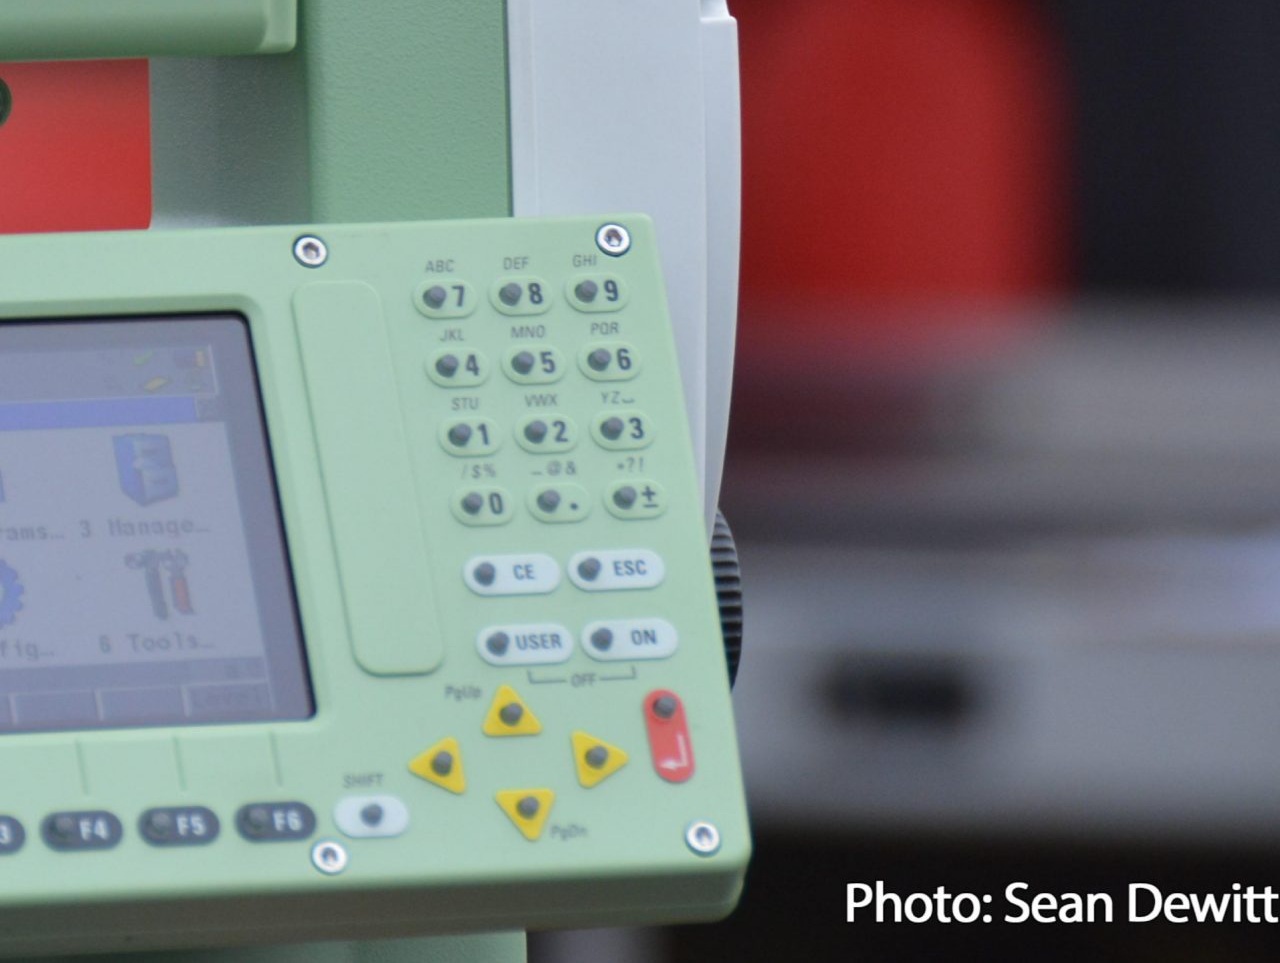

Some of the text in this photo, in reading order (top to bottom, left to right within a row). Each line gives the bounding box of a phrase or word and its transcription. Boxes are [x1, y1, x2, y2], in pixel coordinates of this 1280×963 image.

[425, 260, 455, 273] ABC
[503, 256, 530, 270] DEF
[572, 254, 597, 268] GHI
[451, 285, 465, 307] 7
[528, 282, 543, 305] 8
[604, 279, 619, 302] 9
[440, 328, 464, 342] JKL
[511, 325, 546, 339] MNO
[591, 322, 619, 336] PQR
[465, 354, 480, 376] 4
[540, 351, 555, 374] 5
[616, 348, 631, 370] 6
[451, 397, 479, 410] STU
[524, 394, 558, 407] VWX
[477, 423, 489, 446] 1
[553, 420, 568, 443] 2
[629, 417, 644, 439] 3
[489, 493, 503, 515] 0
[79, 520, 92, 538] 3
[513, 564, 536, 581] CE
[613, 560, 647, 577] ESC
[99, 635, 111, 654] 6
[516, 634, 562, 650] USER
[631, 629, 658, 646] ON
[571, 673, 596, 687] OFF
[445, 685, 481, 701] PgUp
[343, 773, 383, 789] SHIFT
[177, 814, 206, 836] F5
[273, 809, 302, 831] F6
[80, 818, 108, 840] F4
